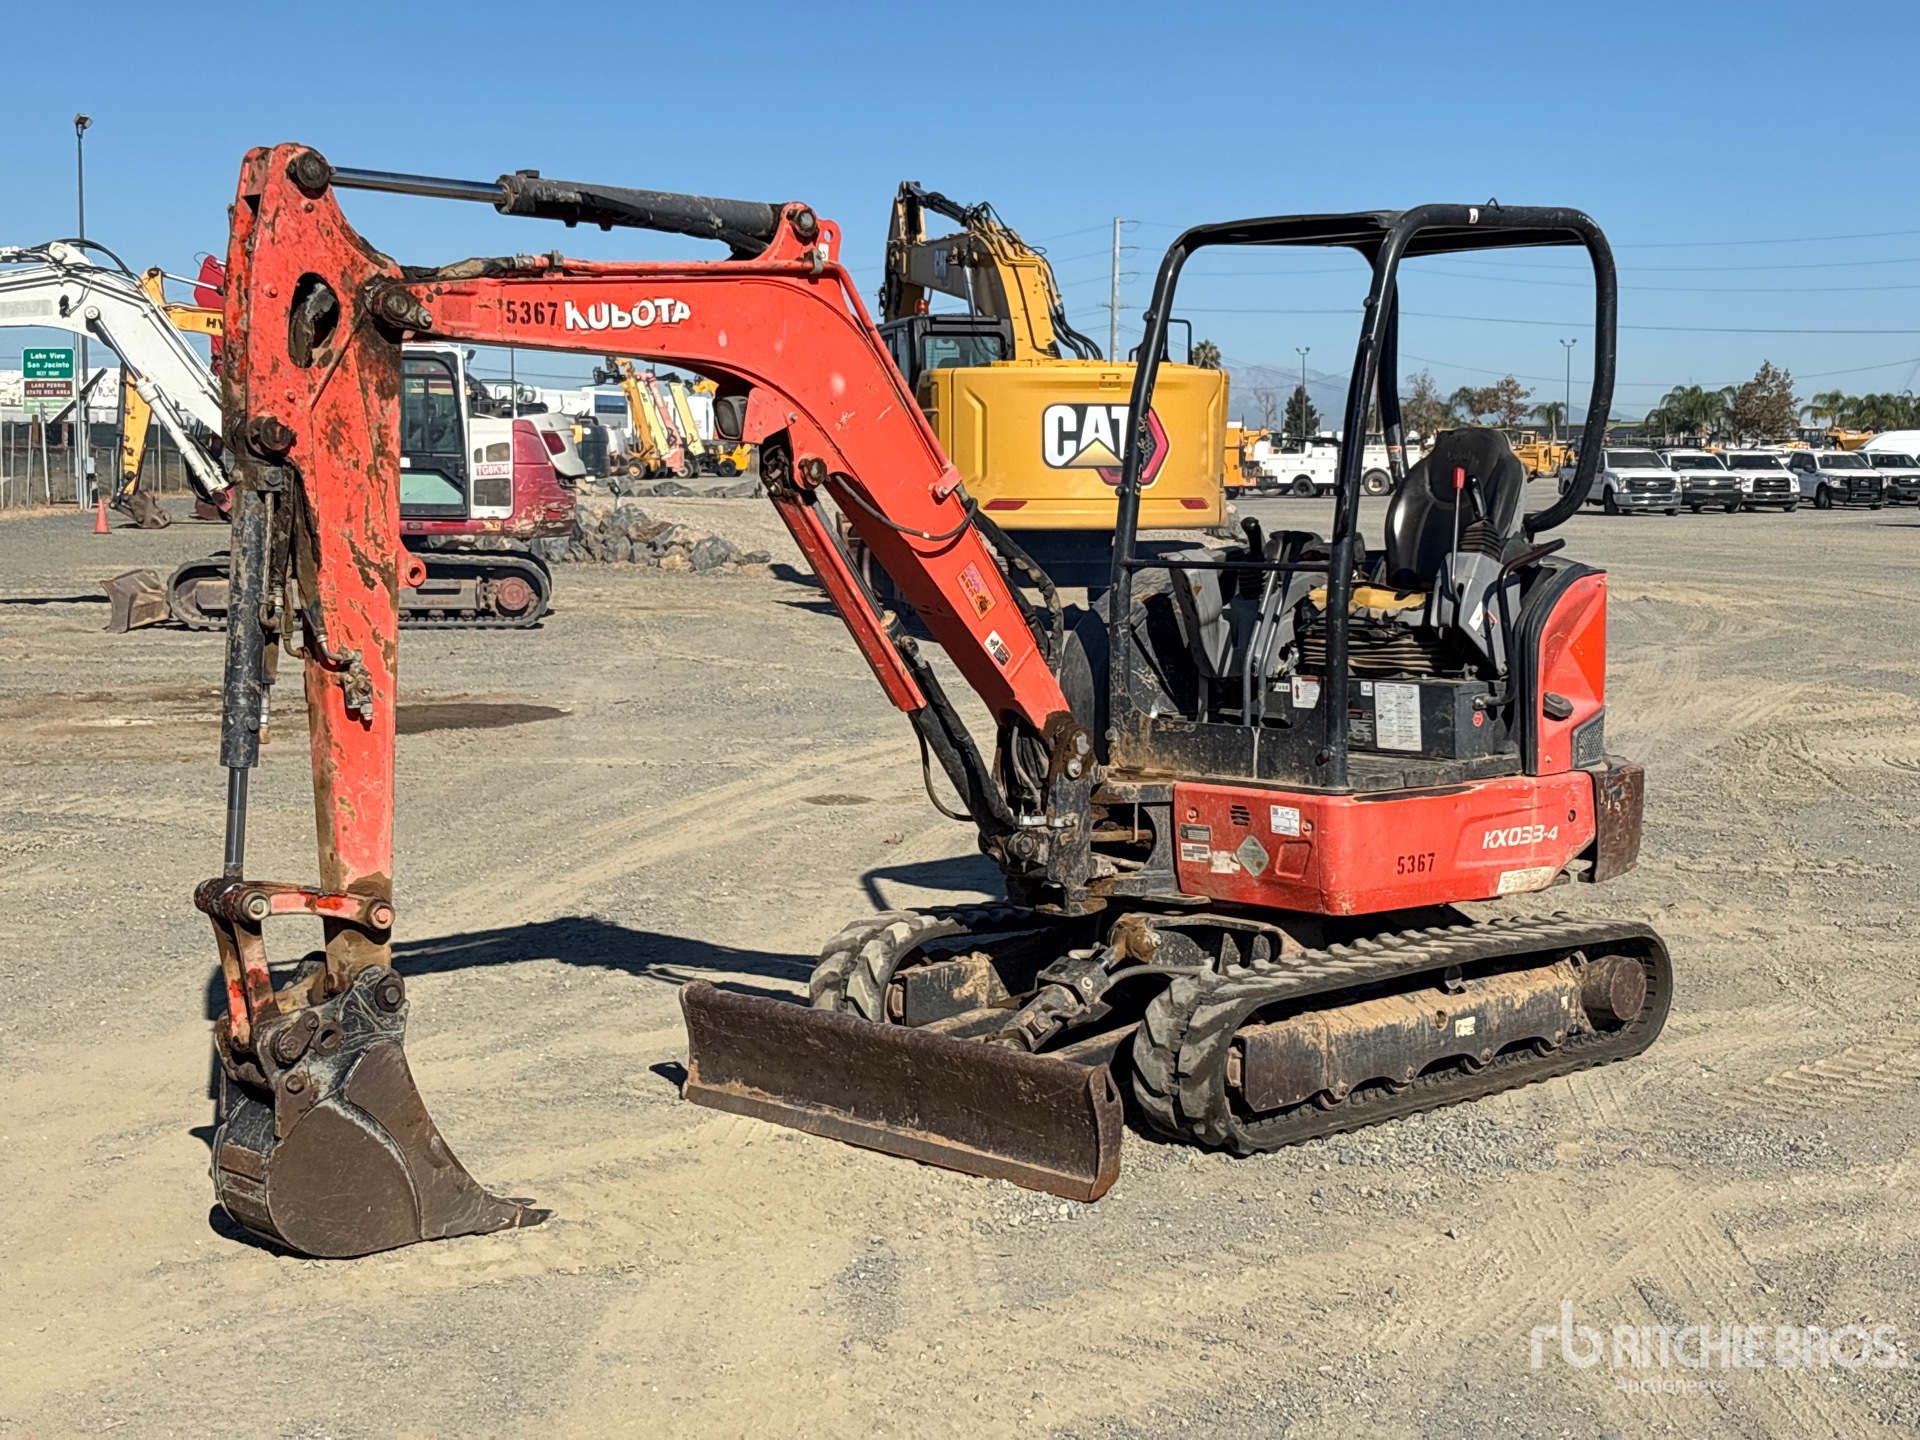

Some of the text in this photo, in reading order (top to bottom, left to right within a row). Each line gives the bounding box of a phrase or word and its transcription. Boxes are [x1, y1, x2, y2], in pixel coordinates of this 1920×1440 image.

[506, 301, 558, 326] 5367
[1482, 825, 1559, 849] KX033-4
[1397, 852, 1436, 874] 5367
